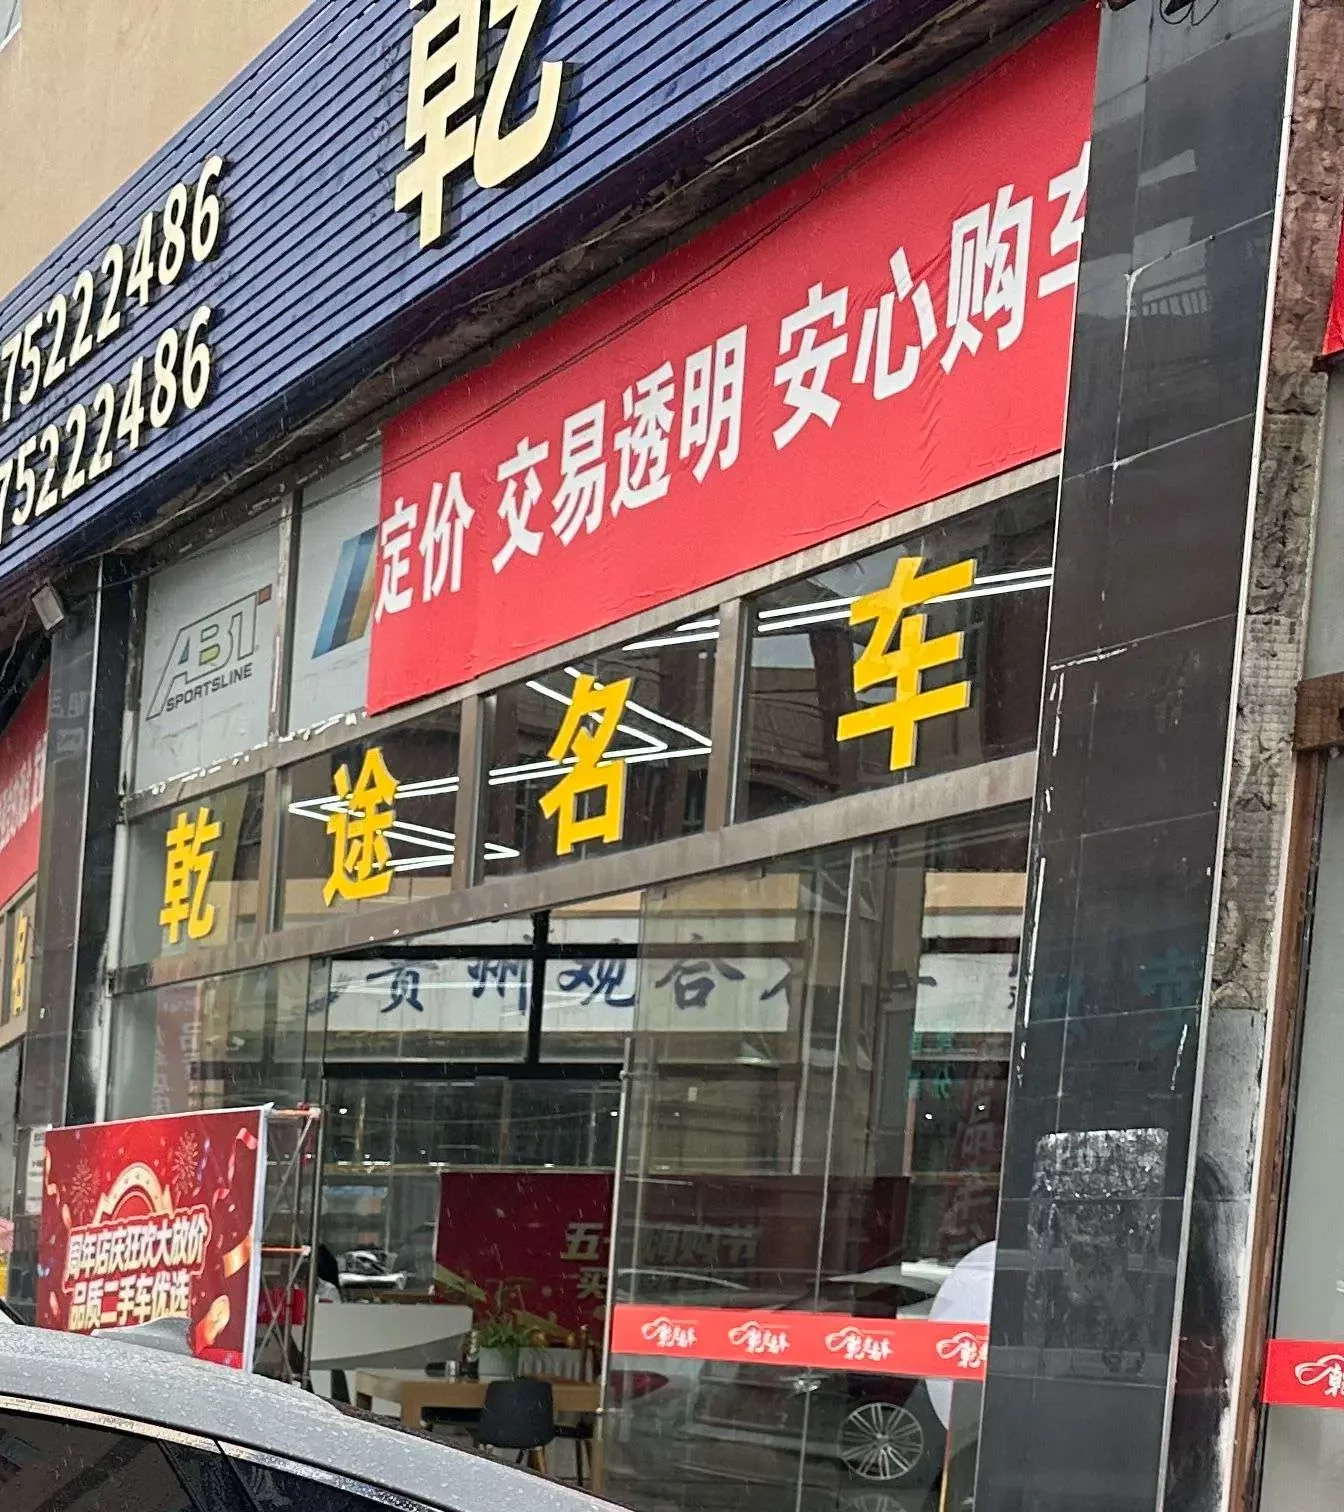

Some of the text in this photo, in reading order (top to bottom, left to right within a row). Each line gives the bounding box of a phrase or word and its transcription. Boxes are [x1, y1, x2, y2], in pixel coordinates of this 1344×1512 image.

[492, 324, 748, 575] 交易透明
[166, 662, 253, 712] SPORTSLINE
[158, 555, 978, 946] 乾途名车
[65, 1213, 208, 1281] 周年店庆狂欢大放价
[68, 1269, 191, 1331] 品质二手车优选
